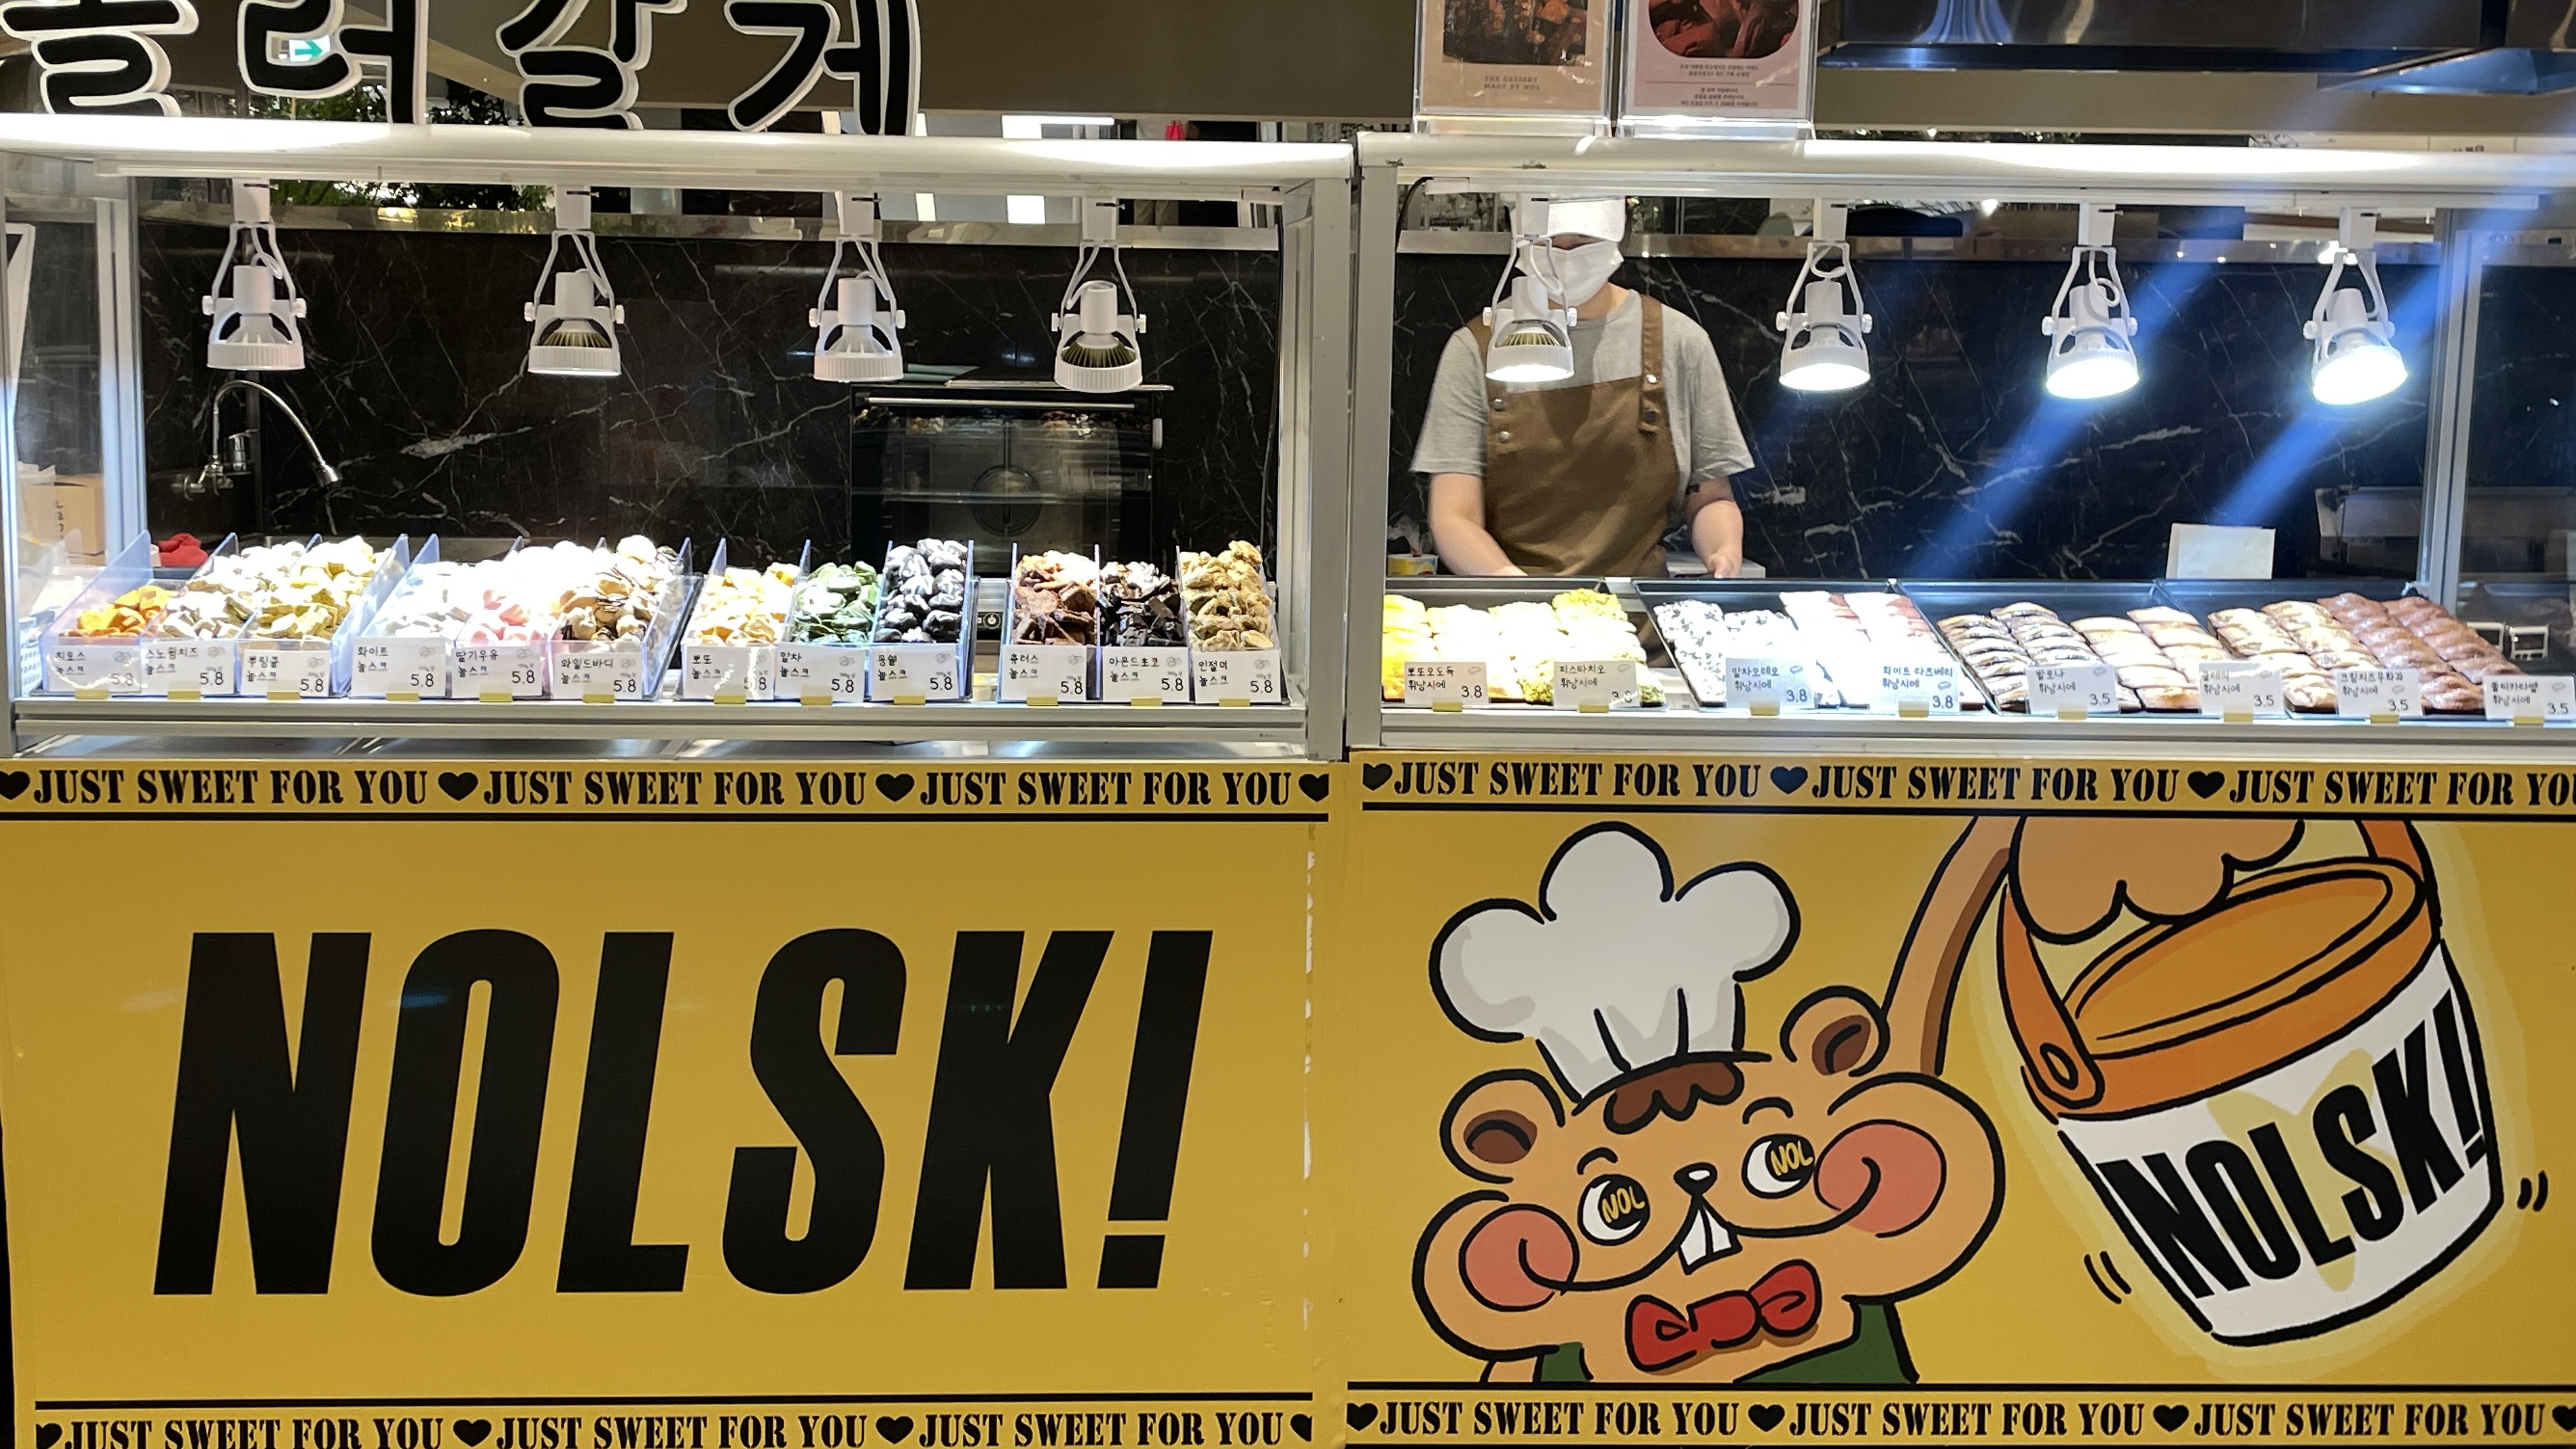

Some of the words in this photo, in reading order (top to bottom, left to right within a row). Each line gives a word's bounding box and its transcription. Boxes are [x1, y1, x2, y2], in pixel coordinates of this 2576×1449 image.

[357, 646, 388, 657] 화이트
[456, 649, 498, 663] 딸기우유
[692, 654, 712, 664] 뽀또
[780, 651, 802, 663] 말차
[1009, 653, 1039, 664] 츄러스
[561, 658, 613, 670] 와일드바디
[1109, 656, 1160, 667] 아몬드초코
[1559, 664, 1606, 674] 피스타치오
[200, 671, 224, 686] 5.8
[512, 670, 535, 685] 5.8
[1732, 664, 1780, 678] 말차오레오
[300, 678, 324, 693] 5.8
[410, 673, 434, 687] 5.8
[613, 679, 636, 693] 5.8
[744, 677, 767, 691] 58
[831, 678, 854, 693] 5.8
[930, 677, 953, 691] 5.8
[1061, 680, 1083, 695] 5.8
[1161, 677, 1184, 692] 5.8
[1250, 679, 1273, 694] 5.8
[1407, 679, 1446, 691] 휘낭시에
[1560, 677, 1598, 689] 휘낭시에
[1461, 685, 1483, 699] 3.8
[1786, 688, 1807, 703] 3.8
[2090, 693, 2111, 706] 3.5
[1933, 695, 1954, 709] 3.8
[2254, 694, 2274, 708] 3.5
[2388, 699, 2409, 712] 3.5
[2547, 703, 2569, 716] 3.5
[34, 770, 124, 804] JUST
[138, 770, 258, 804] SWEET
[270, 770, 344, 804] FOR
[355, 770, 428, 804] YOU
[1394, 762, 1479, 795] JUST
[1490, 762, 1602, 795] SWEET
[1613, 764, 1681, 797] FOR
[1693, 765, 1761, 797] YOU
[1812, 766, 1897, 799] JUST
[1908, 767, 2021, 800] SWEET
[2031, 768, 2098, 801] FOR
[2111, 769, 2179, 802] YOU
[484, 771, 572, 805] JUST
[585, 772, 702, 805] SWEET
[714, 772, 785, 805] FOR
[796, 772, 866, 806] YOU
[920, 772, 1006, 806] JUST
[1018, 772, 1132, 805] SWEET
[1144, 772, 1211, 805] FOR
[1223, 772, 1291, 805] YOU
[2229, 770, 2315, 804] JUST
[2324, 771, 2437, 805] SWEET
[2447, 772, 2514, 806] FOR
[153, 928, 1213, 1298] NOLSK!
[2096, 988, 2487, 1300] NOLSK!
[1770, 1140, 1814, 1176] NOL
[1602, 1186, 1646, 1223] NOL
[1379, 1402, 1462, 1435] JUST
[1474, 1402, 1584, 1435] SWEET
[1595, 1403, 1661, 1436] FOR
[1673, 1403, 1739, 1436] YOU
[1789, 1403, 1871, 1436] JUST
[1882, 1403, 1991, 1436] SWEET
[2003, 1404, 2067, 1436] FOR
[2078, 1404, 2144, 1436] YOU
[2194, 1404, 2276, 1436] JUST
[2286, 1404, 2395, 1436] SWEET
[2405, 1404, 2469, 1436] FOR
[2481, 1404, 2545, 1436] YOU
[64, 1420, 152, 1449] JUST
[165, 1420, 280, 1449] SWEET
[293, 1419, 362, 1449] FOR
[373, 1418, 443, 1449] YOU
[496, 1418, 582, 1449] JUST
[594, 1416, 707, 1449] SWEET
[719, 1416, 787, 1449] FOR
[799, 1414, 866, 1448] YOU
[919, 1414, 1003, 1448] JUST
[1015, 1414, 1126, 1447] SWEET
[1138, 1413, 1205, 1446] FOR
[1216, 1413, 1284, 1445] YOU
